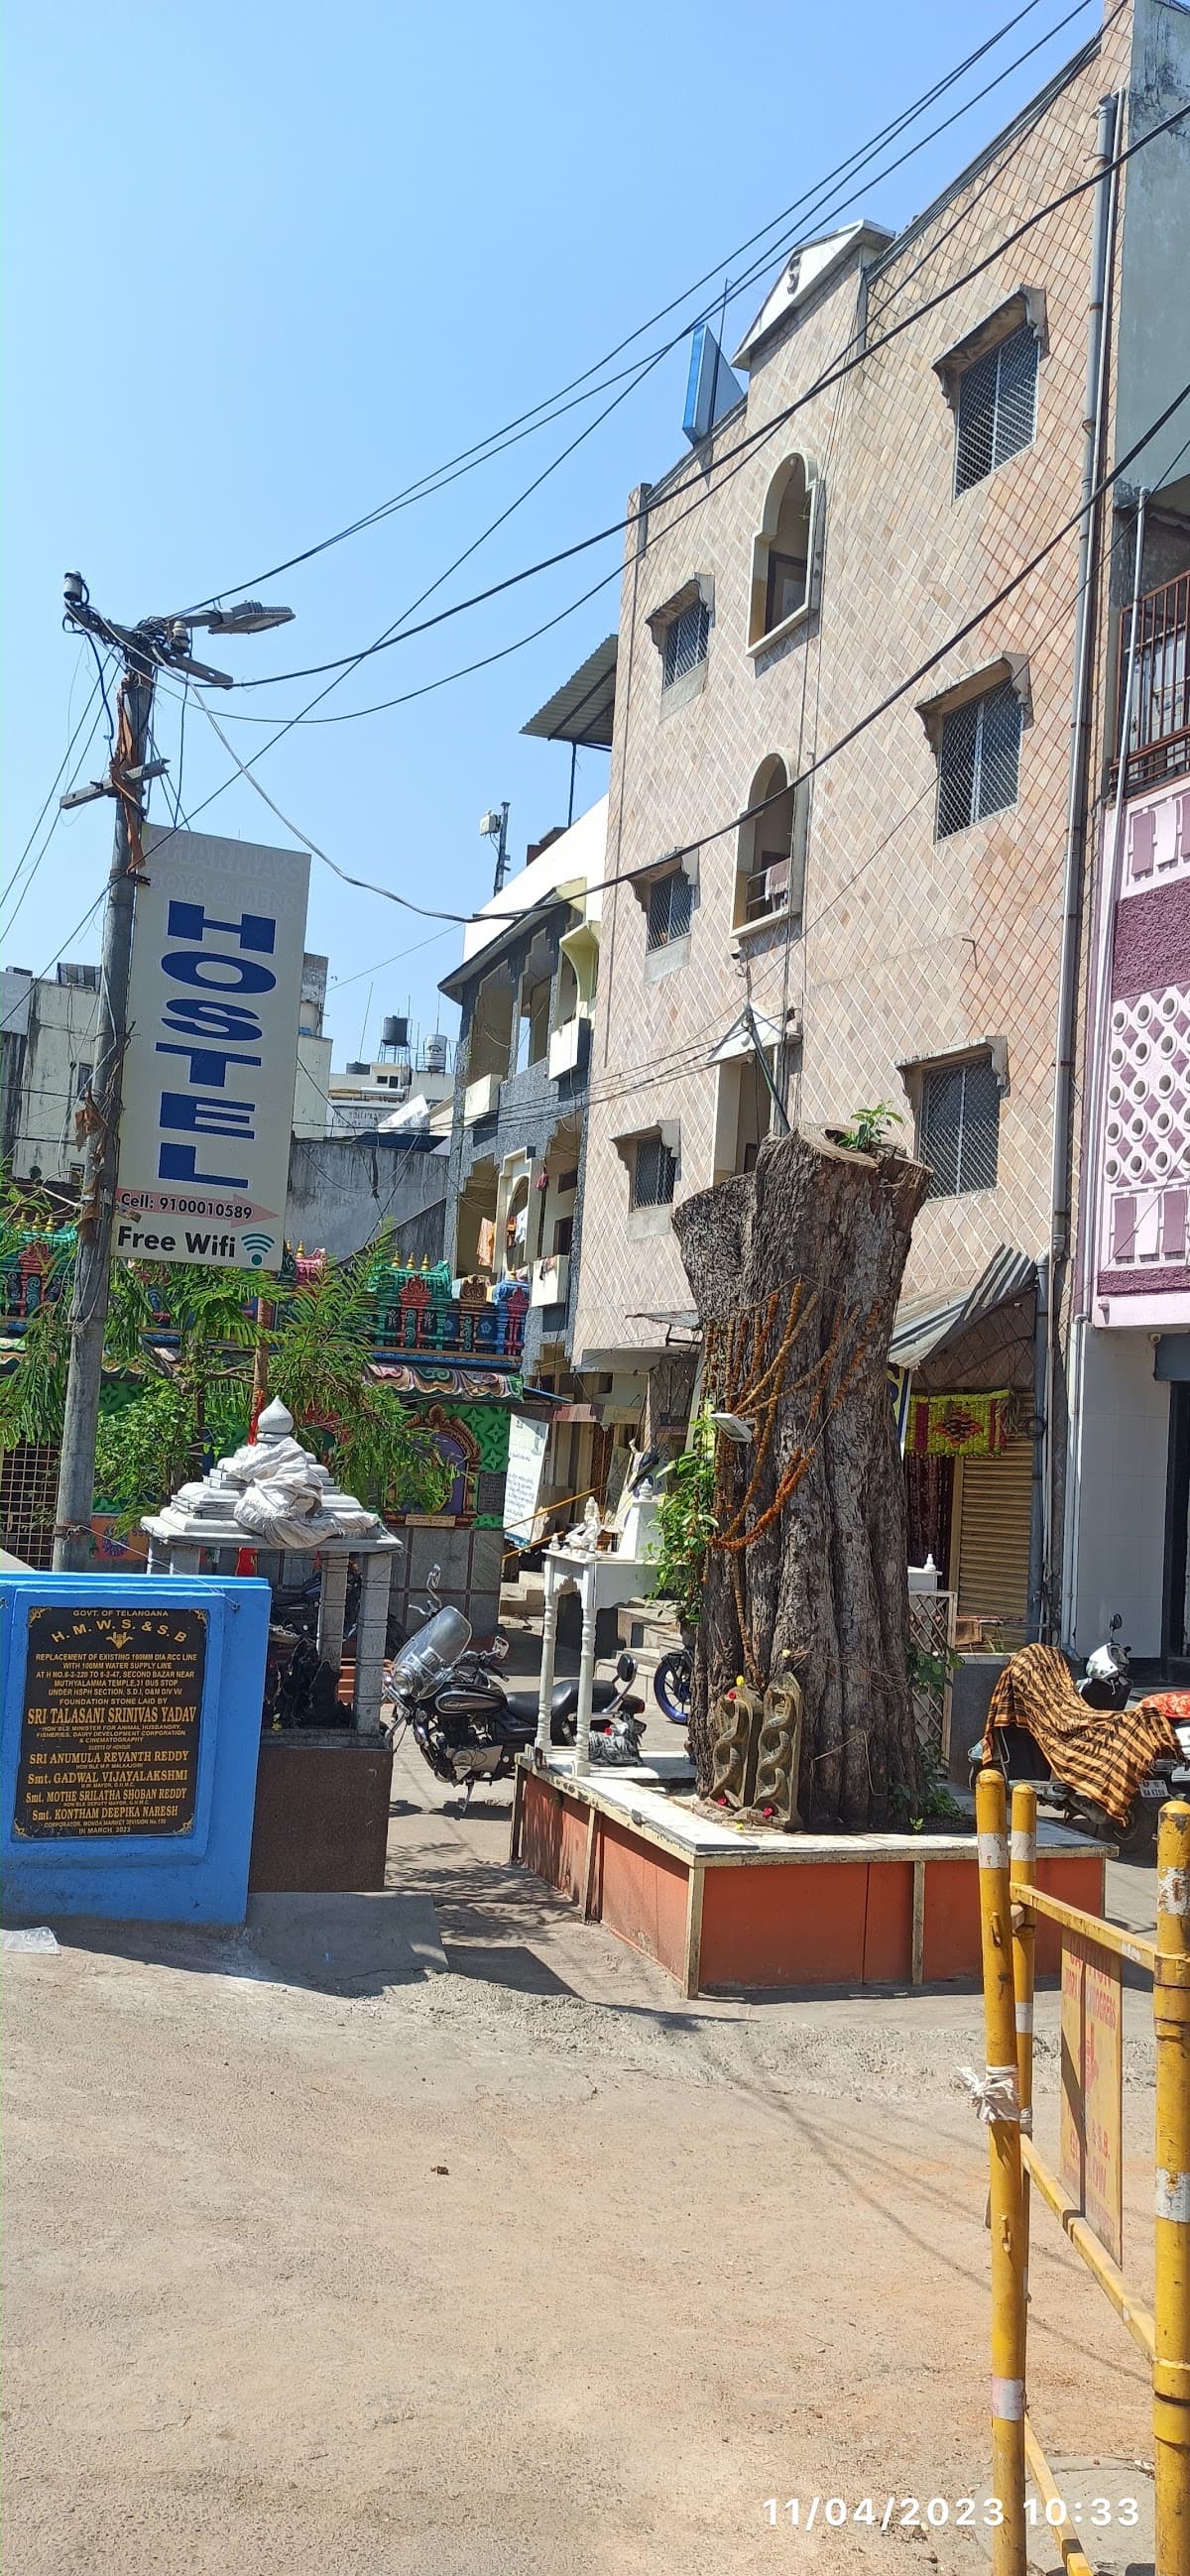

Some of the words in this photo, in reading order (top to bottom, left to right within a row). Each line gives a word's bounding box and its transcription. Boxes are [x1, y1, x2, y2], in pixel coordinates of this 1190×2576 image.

[155, 899, 277, 1189] HOSTEL
[121, 1193, 154, 1209] Cell:
[160, 1197, 253, 1220] 9100010589
[117, 1226, 177, 1251] Free
[184, 1231, 236, 1258] Wifi
[141, 1621, 153, 1632] &
[28, 1707, 48, 1724] SRI
[51, 1707, 105, 1724] TALASANI
[108, 1706, 158, 1723] SRINIVAS
[161, 1705, 197, 1722] YADAV
[30, 1753, 48, 1764] SRI
[50, 1752, 101, 1764] ANUMULA
[103, 1751, 152, 1763] REVANTH
[154, 1750, 189, 1762] REDDY
[27, 1773, 51, 1785] Smt.
[54, 1772, 99, 1784] GADWAL
[102, 1770, 188, 1783] VIJAYALAKSHMI
[26, 1792, 44, 1804] Smt.
[47, 1791, 77, 1803] MOTHE
[78, 1790, 121, 1802] SRILATHA
[123, 1788, 157, 1801] SHOBAN
[159, 1788, 187, 1800] REDDY
[32, 1810, 52, 1820] Smt.
[55, 1808, 99, 1820] KONTHAM
[101, 1807, 141, 1818] DEEPIKA
[142, 1806, 178, 1816] NARESH
